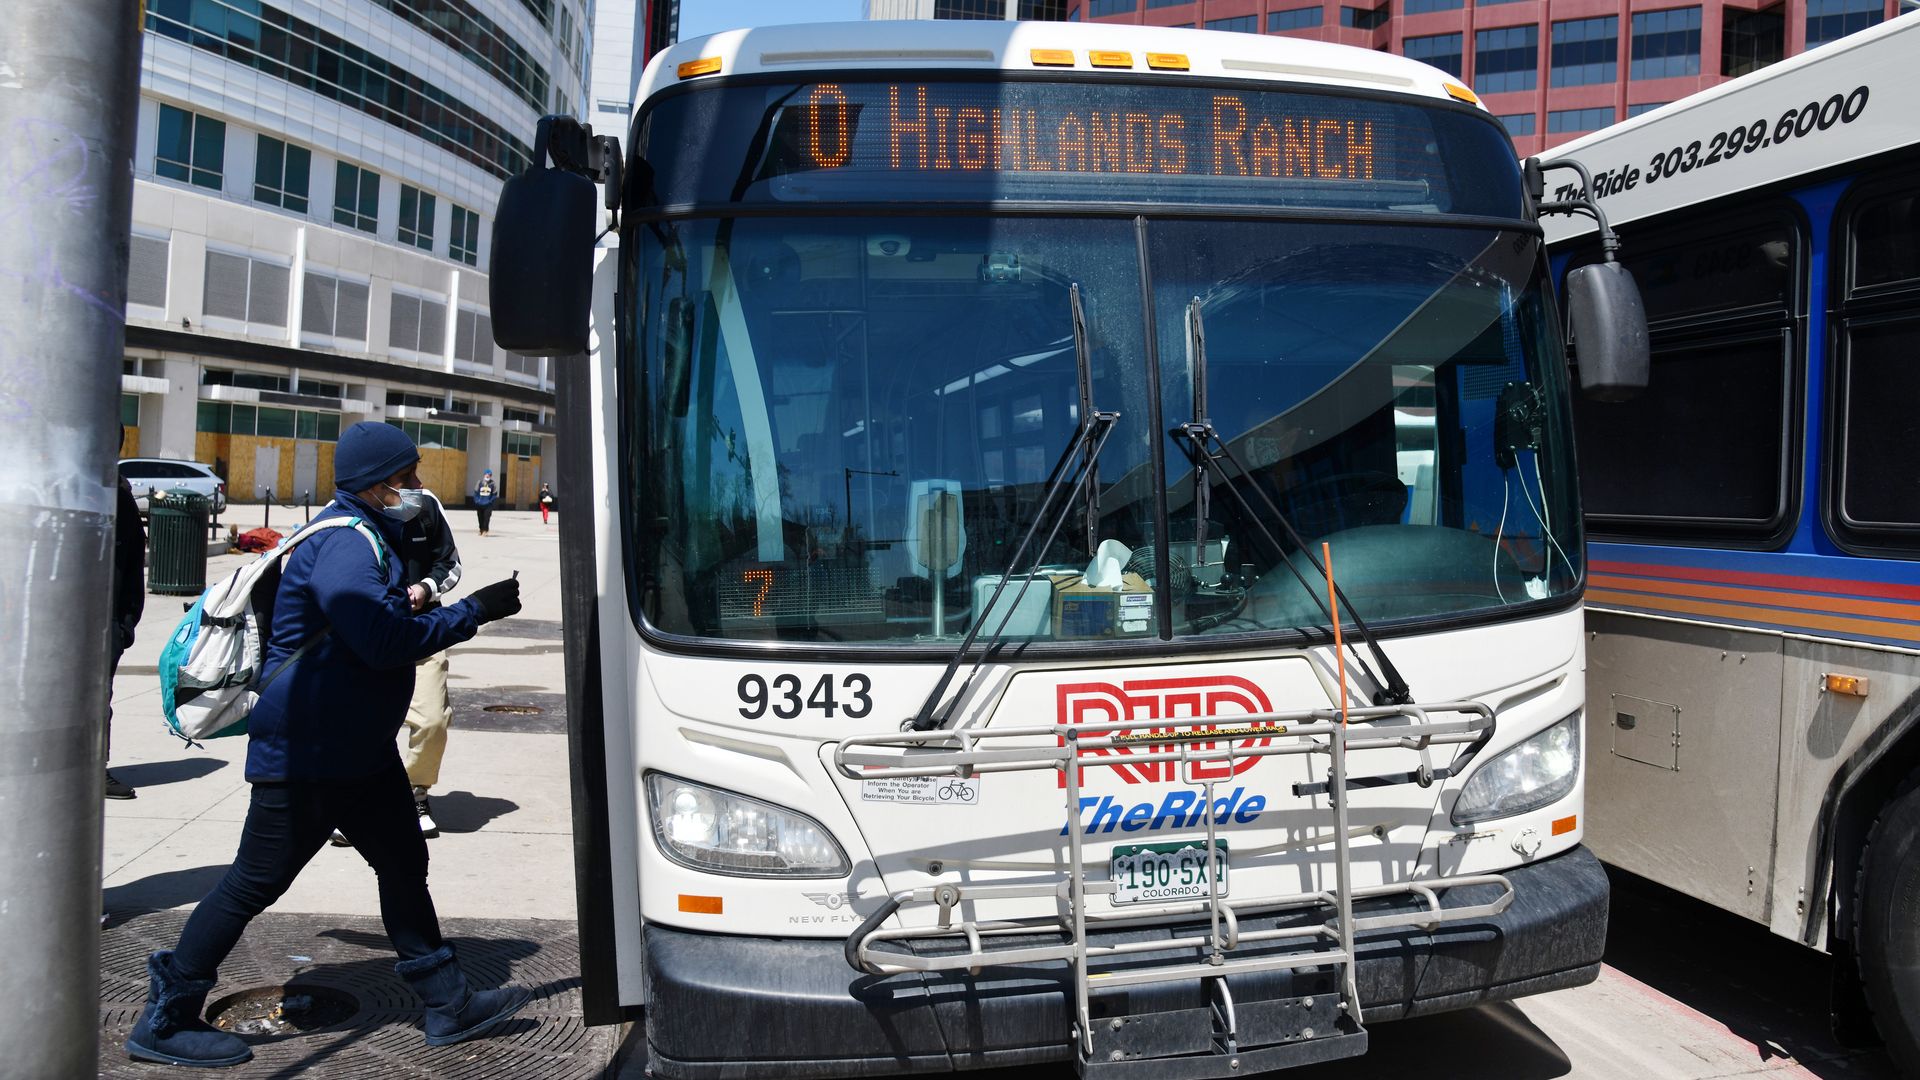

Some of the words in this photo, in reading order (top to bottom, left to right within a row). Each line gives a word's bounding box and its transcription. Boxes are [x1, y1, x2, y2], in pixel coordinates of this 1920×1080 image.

[889, 85, 1186, 173] HIGHLANDS
[1212, 95, 1373, 180] RANCH
[1645, 85, 1870, 184] 303.299.6000
[743, 570, 773, 617] 7
[737, 673, 873, 720] 9343
[1056, 675, 1275, 789] RTD
[863, 793, 895, 801] Retrieving
[1059, 787, 1267, 836] TheRide
[1142, 886, 1200, 898] COLORADO
[789, 915, 825, 923] NEW
[831, 914, 867, 922] FLY
